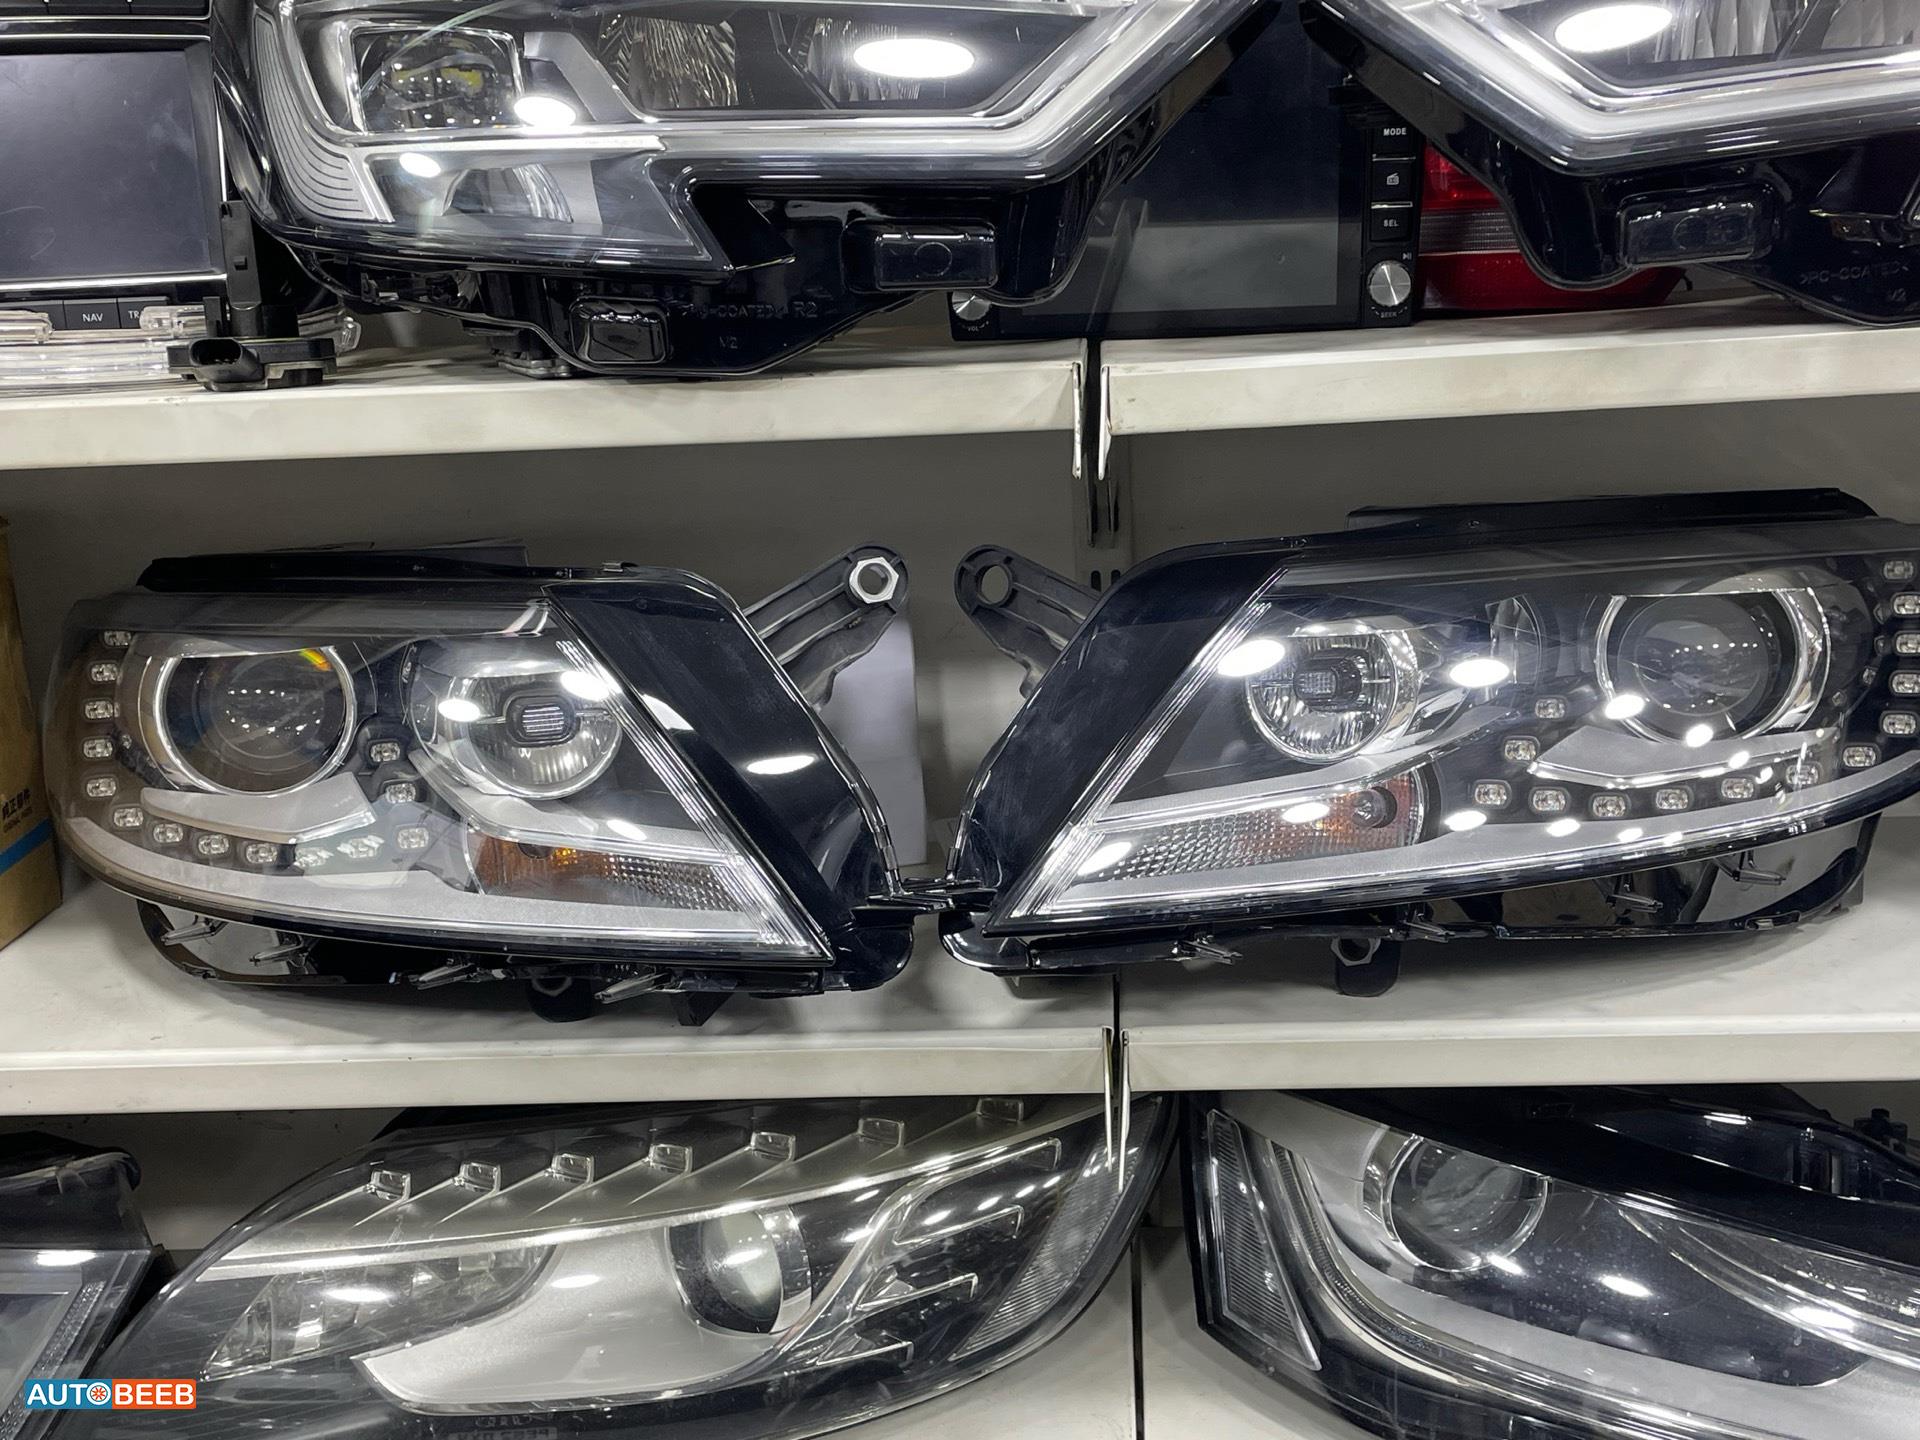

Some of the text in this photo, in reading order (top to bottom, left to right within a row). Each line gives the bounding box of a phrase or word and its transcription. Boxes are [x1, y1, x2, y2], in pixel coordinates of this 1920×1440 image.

[1383, 127, 1407, 136] MODE
[1383, 219, 1399, 227] SEL
[82, 313, 104, 322] NAV
